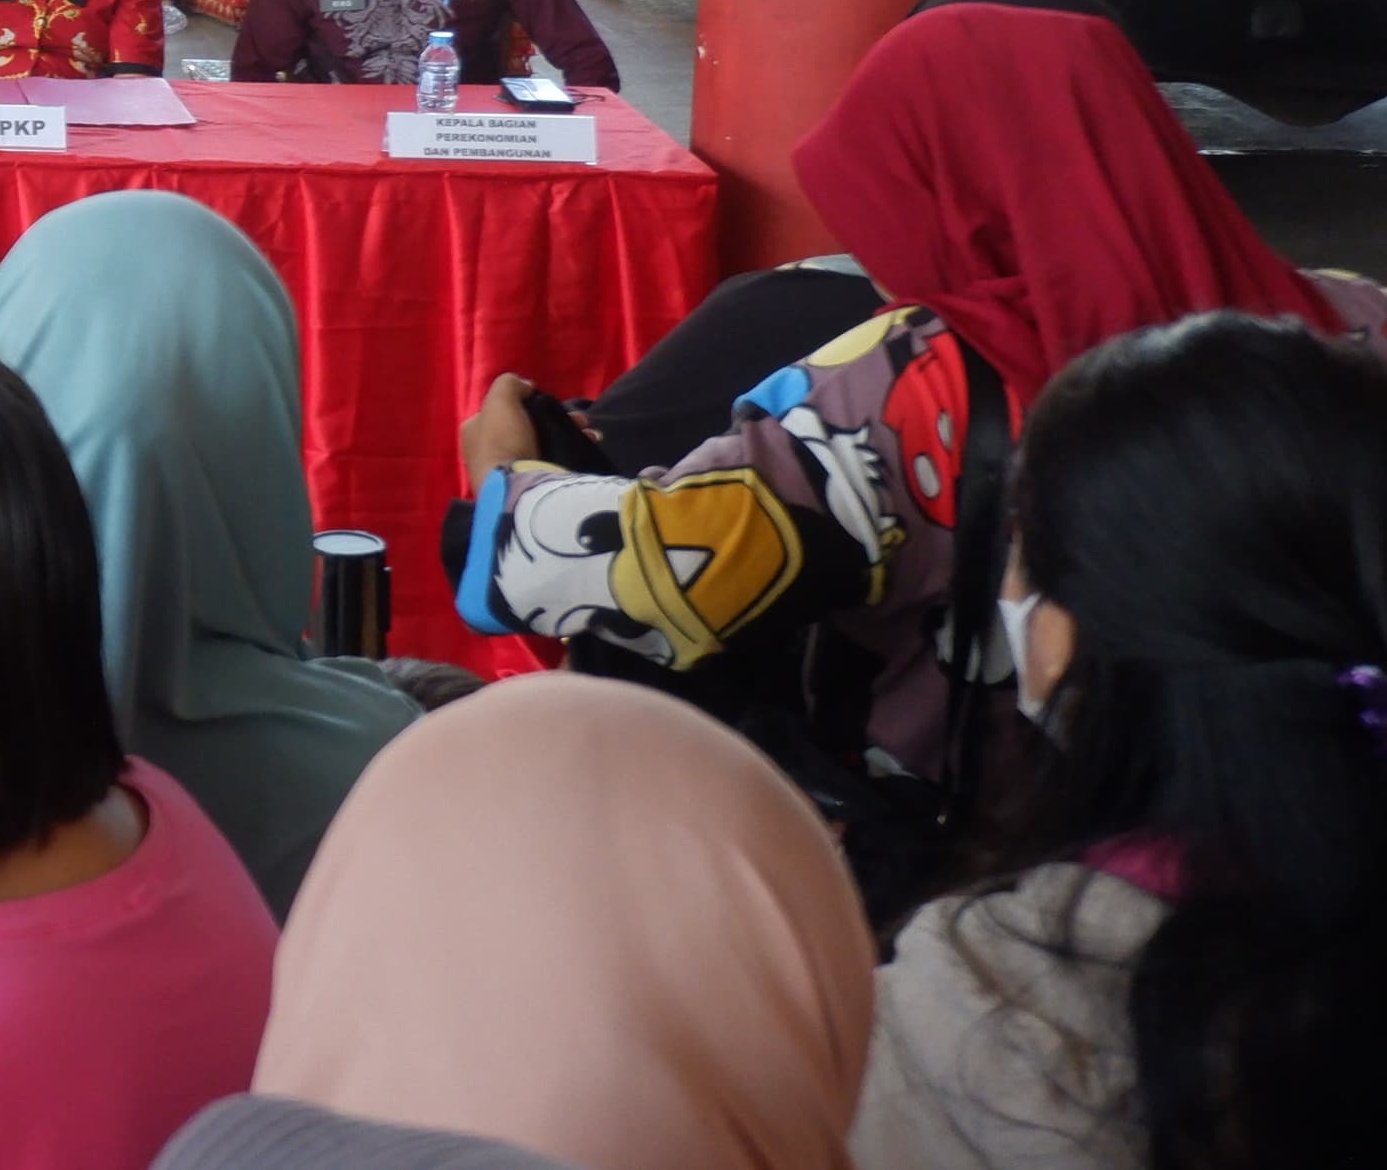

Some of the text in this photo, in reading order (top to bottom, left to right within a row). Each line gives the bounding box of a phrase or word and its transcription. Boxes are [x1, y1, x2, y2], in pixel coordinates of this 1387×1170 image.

[436, 118, 536, 128] KEPALA BAGIAN
[436, 133, 537, 144] PEREKONOMIAN
[424, 147, 552, 158] DAN PEMBANGUNAN
